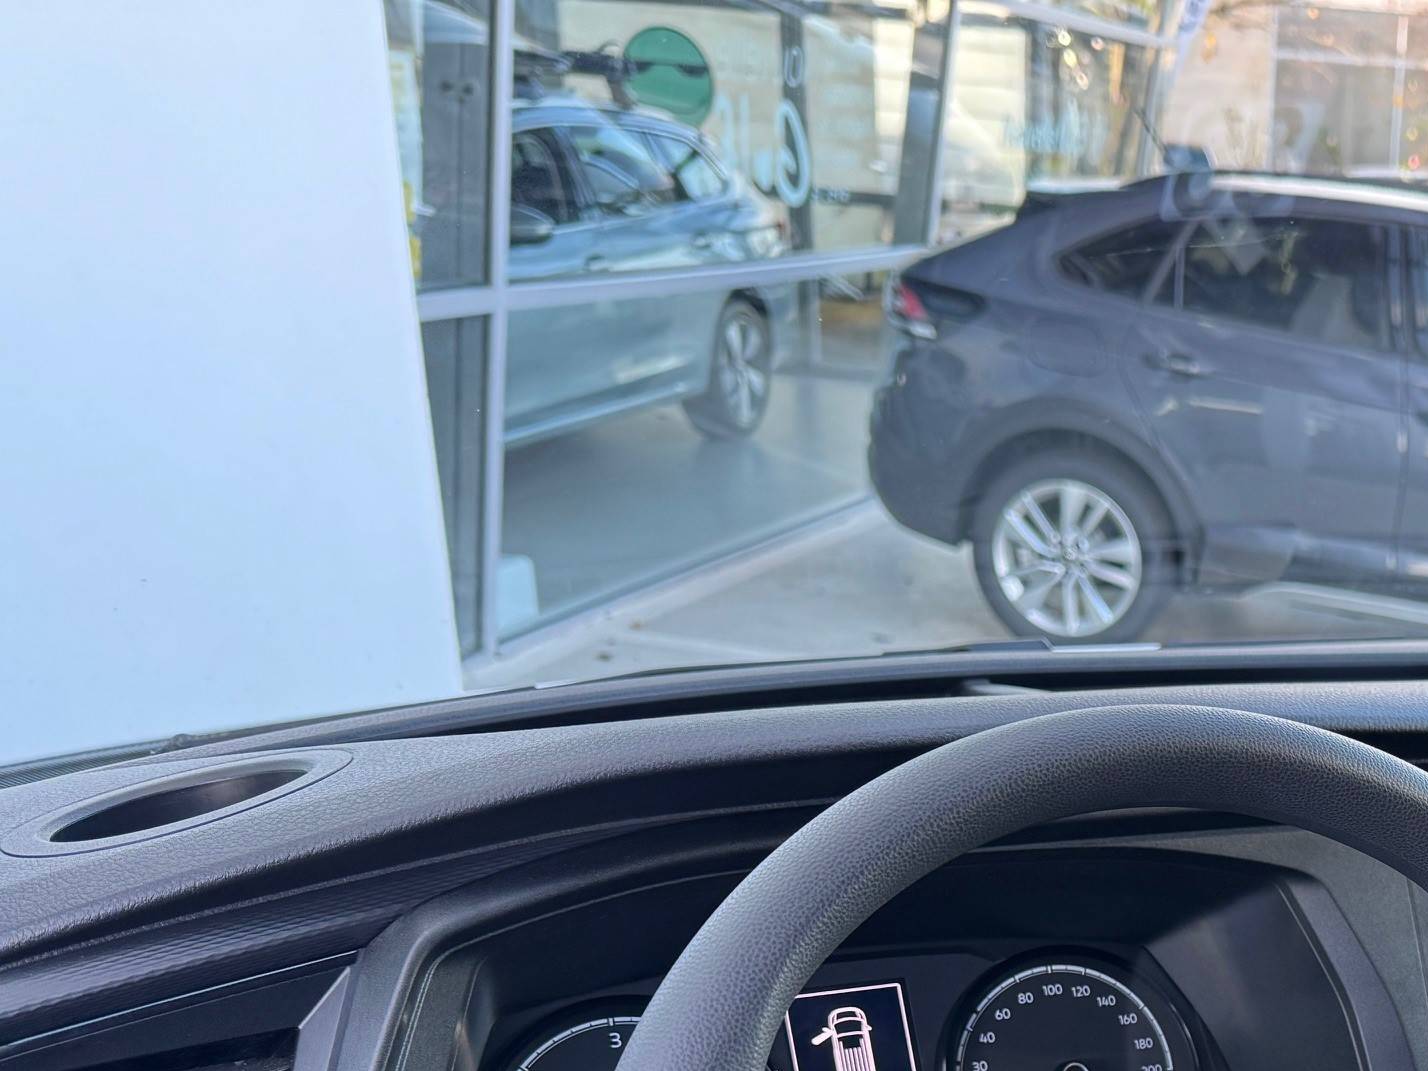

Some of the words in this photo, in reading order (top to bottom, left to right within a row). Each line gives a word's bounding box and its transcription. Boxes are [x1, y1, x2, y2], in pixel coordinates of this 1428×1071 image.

[1042, 983, 1063, 997] 100
[1072, 984, 1091, 998] 120
[1018, 992, 1034, 1005] 80
[1097, 995, 1116, 1008] 140
[995, 1008, 1011, 1021] 60
[1118, 1012, 1138, 1026] 160
[608, 1032, 622, 1049] 3
[979, 1031, 996, 1044] 40
[1134, 1037, 1153, 1050] 180
